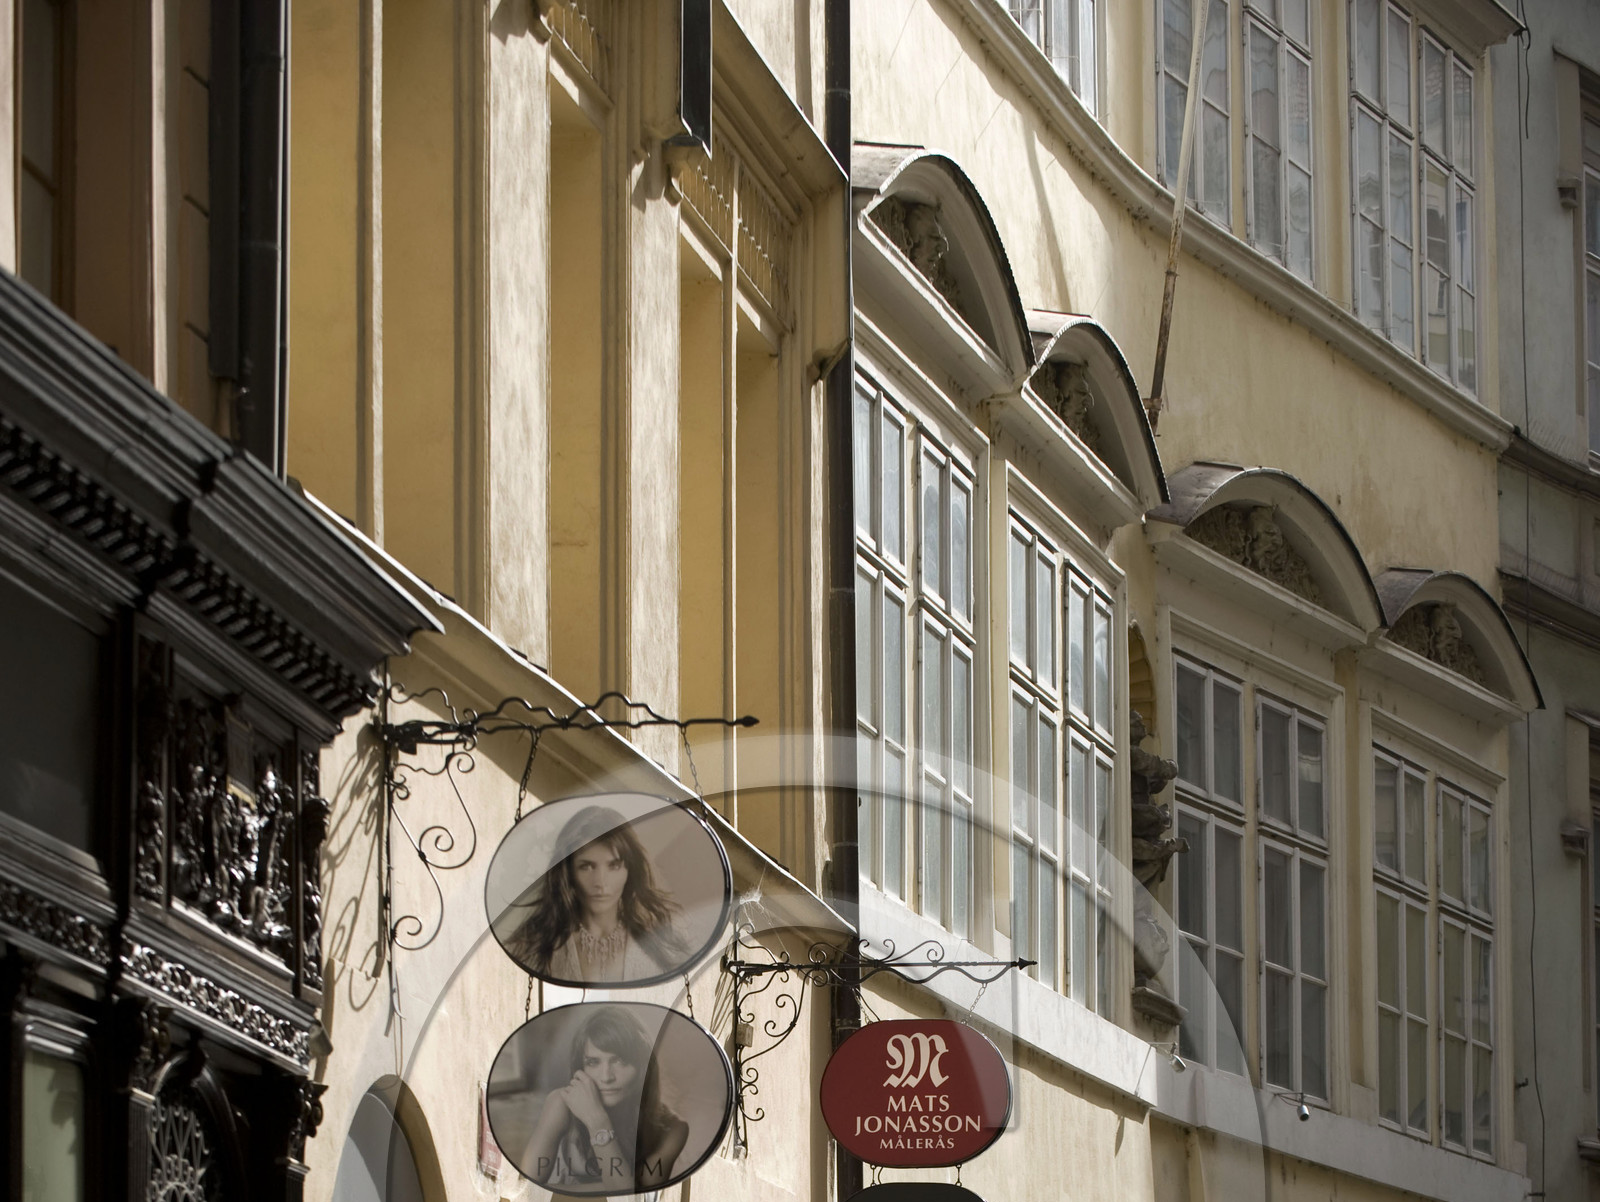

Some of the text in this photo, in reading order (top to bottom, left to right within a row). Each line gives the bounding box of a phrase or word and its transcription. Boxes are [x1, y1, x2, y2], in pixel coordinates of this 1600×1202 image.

[887, 1094, 951, 1113] MATS
[854, 1114, 982, 1137] JONASSON
[879, 1134, 955, 1150] MÅLERÅS
[536, 1156, 664, 1178] PILGRIM
